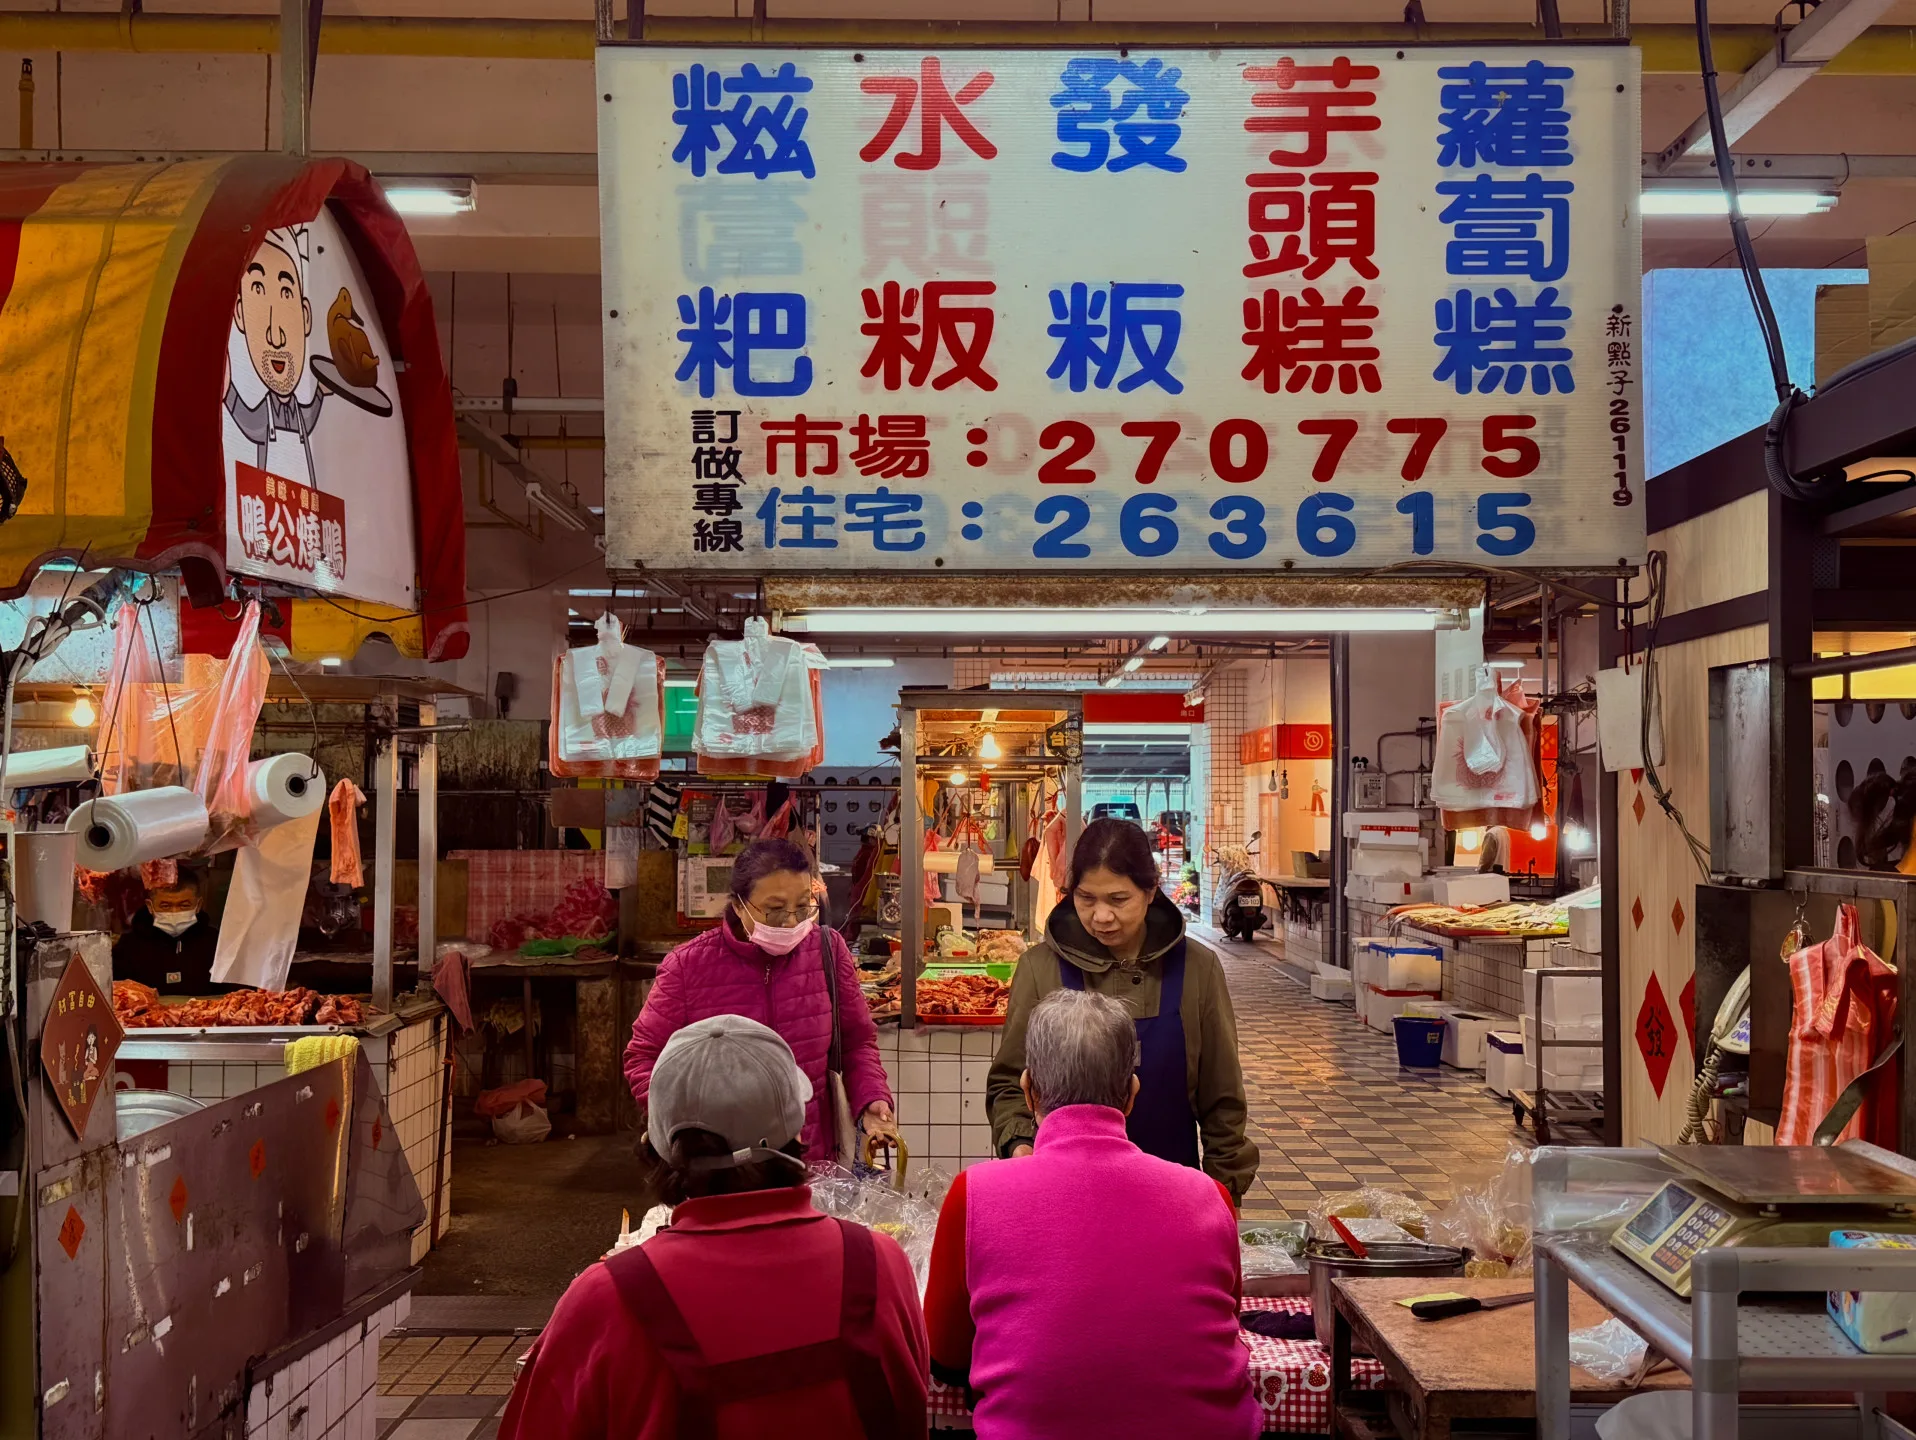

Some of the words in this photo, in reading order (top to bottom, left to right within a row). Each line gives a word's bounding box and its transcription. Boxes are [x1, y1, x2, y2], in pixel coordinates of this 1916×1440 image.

[859, 56, 999, 392] 水粄
[1047, 57, 1191, 395] 發粄
[1241, 56, 1383, 395] 芋頭糕
[1433, 59, 1575, 395] 蘿蔔糕
[239, 493, 345, 580] 鴨公燒鴨
[690, 409, 745, 553] 訂做專線
[1031, 491, 1537, 559] 263615
[1037, 414, 1541, 485] 270775
